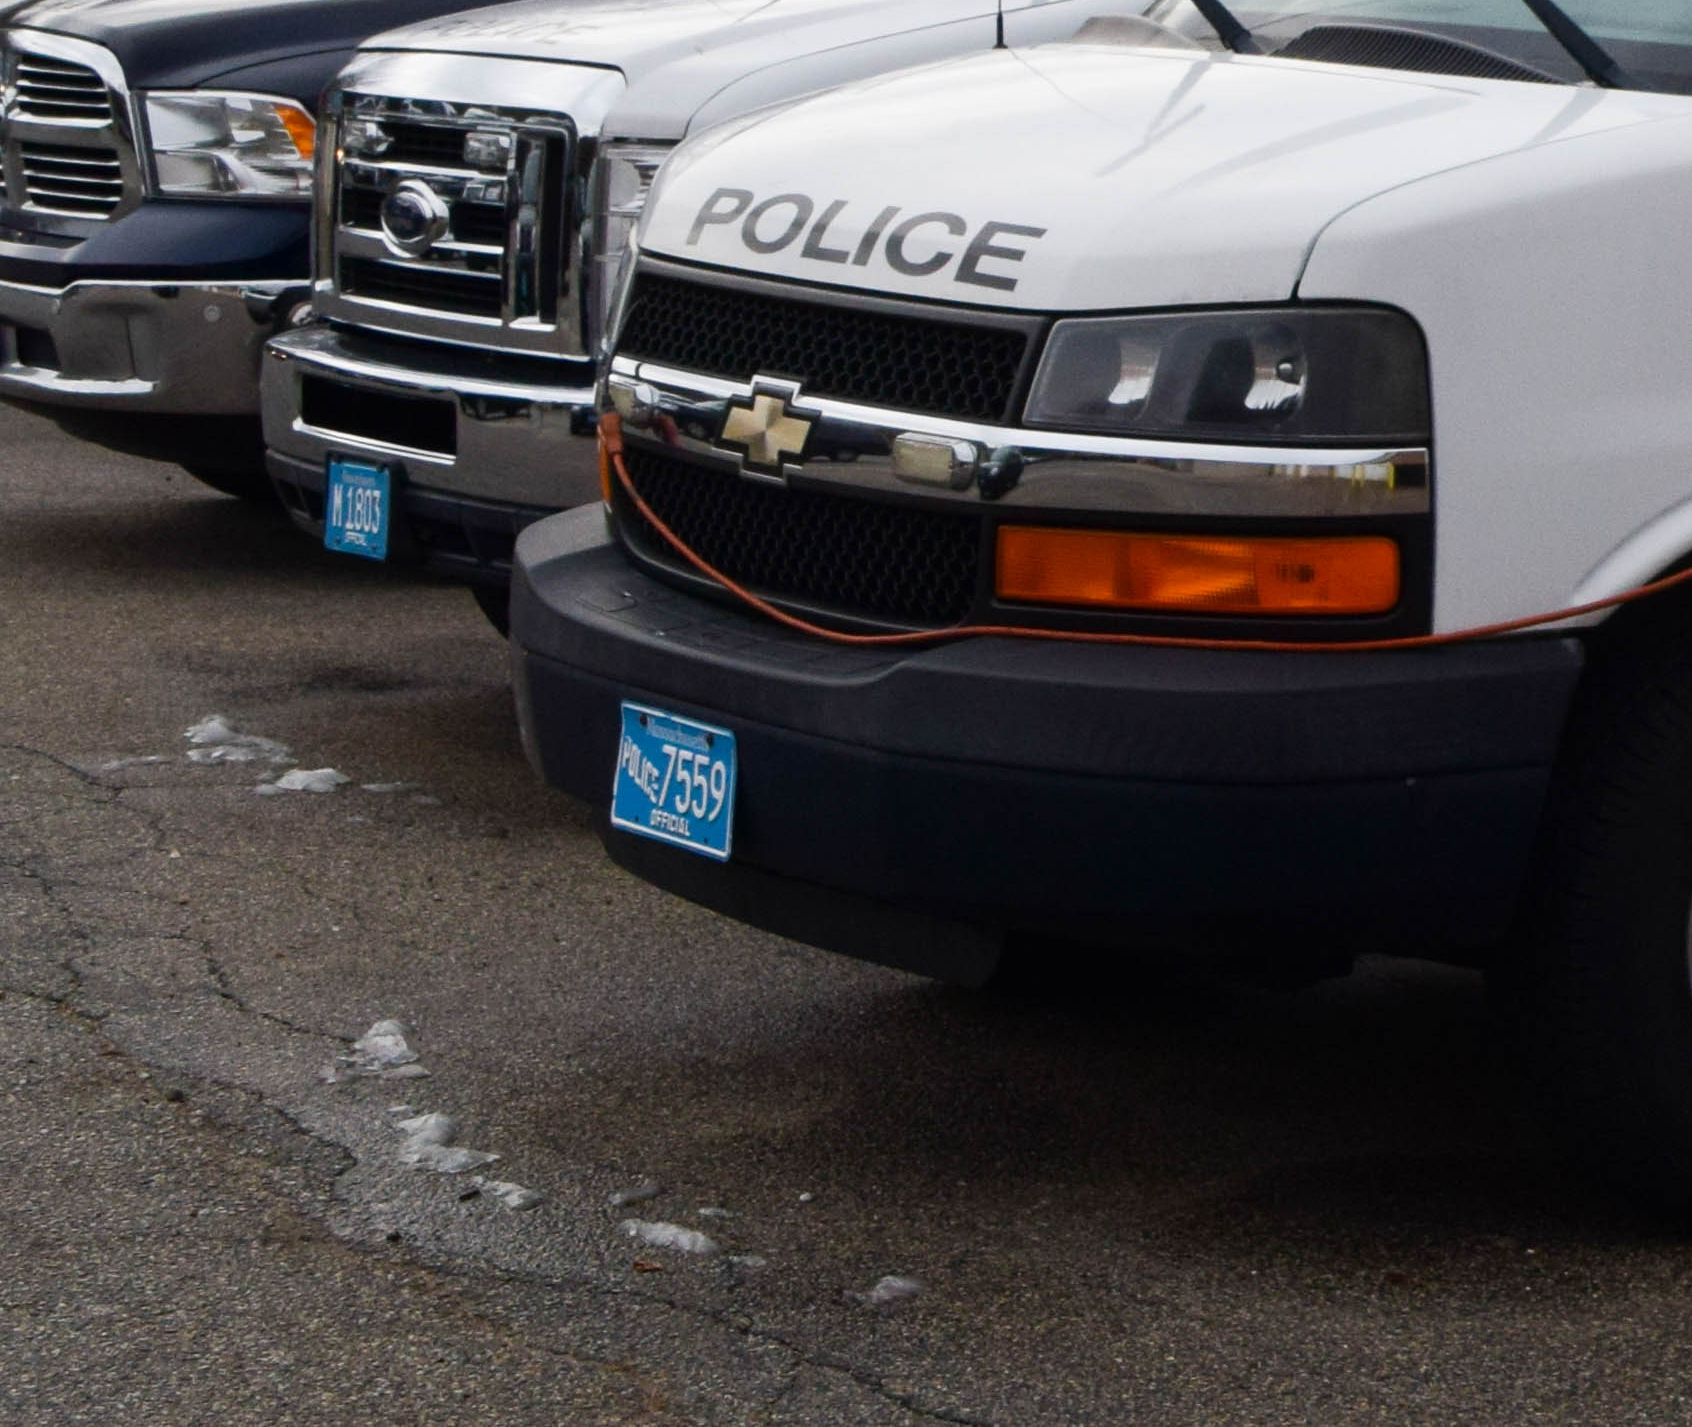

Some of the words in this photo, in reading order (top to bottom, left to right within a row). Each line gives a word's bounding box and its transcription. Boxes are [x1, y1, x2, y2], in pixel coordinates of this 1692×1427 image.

[687, 187, 1048, 292] POLICE
[345, 486, 381, 534] 1803
[658, 743, 726, 822] 7559
